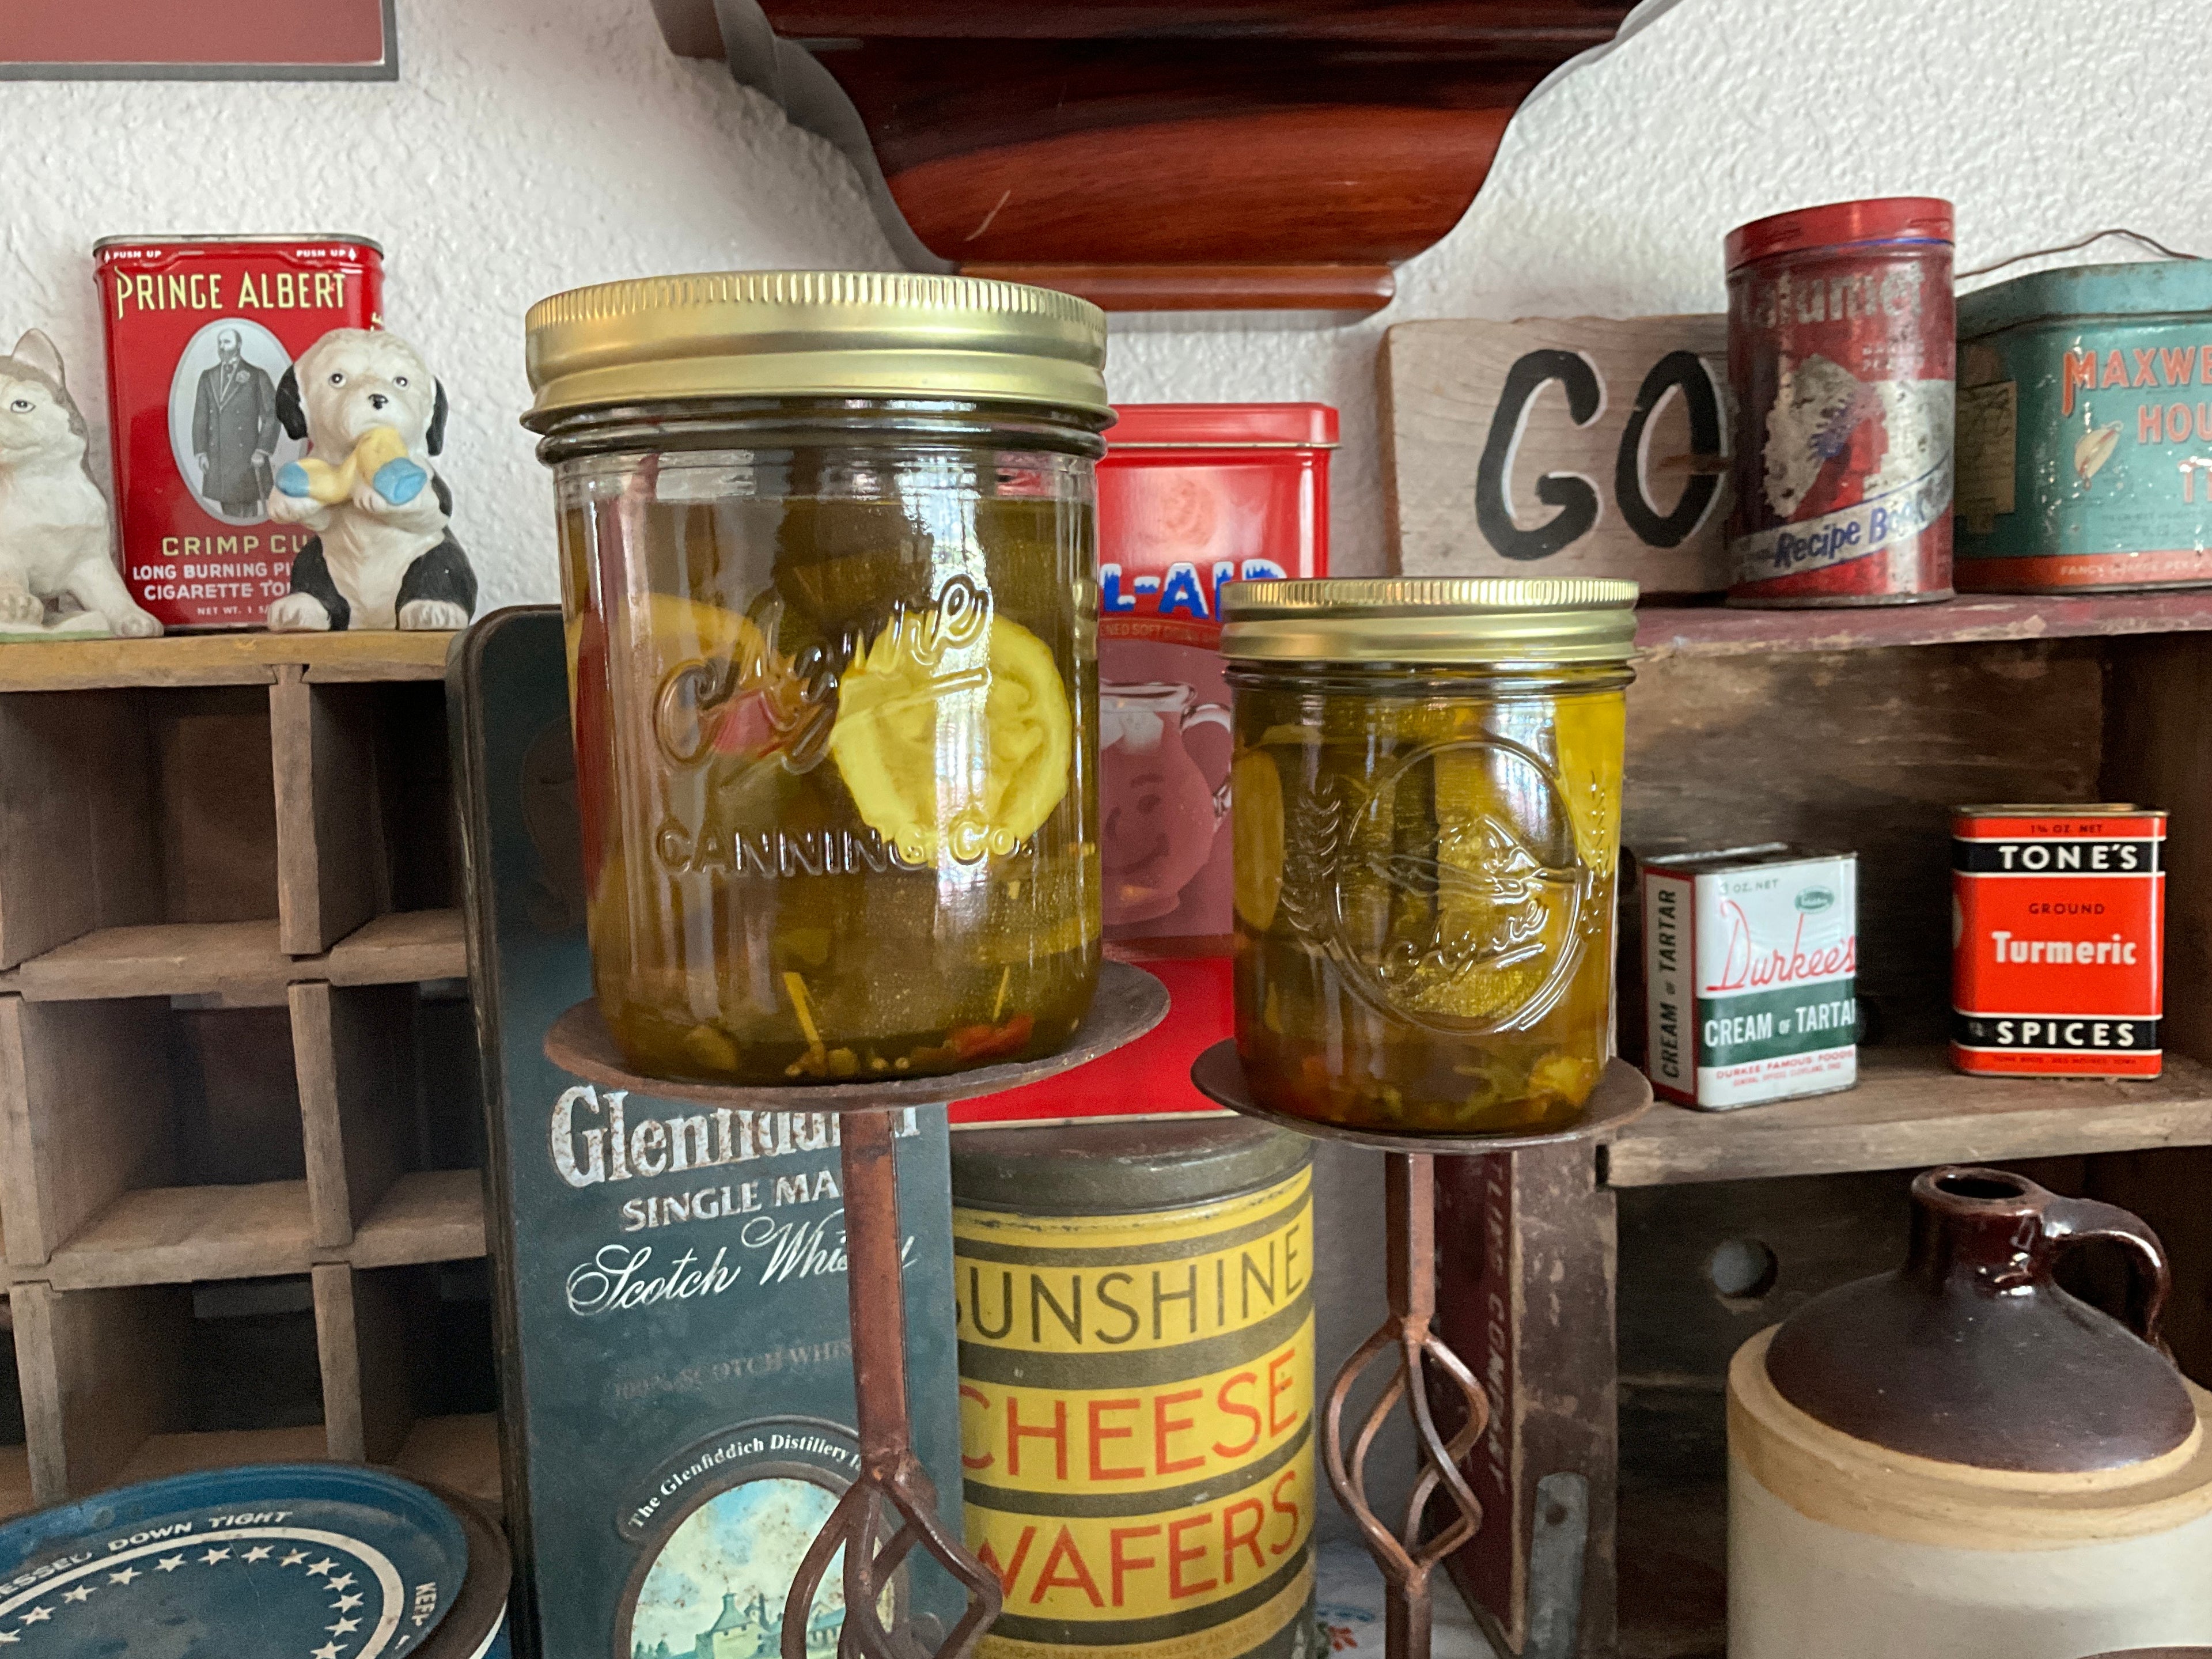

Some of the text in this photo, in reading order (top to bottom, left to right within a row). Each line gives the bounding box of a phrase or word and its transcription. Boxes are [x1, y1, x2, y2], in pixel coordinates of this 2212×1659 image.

[114, 266, 346, 320] PRINCE ALBERT
[2061, 345, 2212, 417] MAXWE
[2138, 402, 2212, 444] HOU
[162, 534, 308, 556] CRIMP CU
[1774, 520, 1861, 569] Recipe
[132, 562, 290, 581] LONG BURNING PI
[143, 582, 253, 600] CIGARETTE
[196, 606, 217, 615] NET
[2079, 824, 2103, 833] NET
[654, 827, 931, 877] CANNING
[1999, 844, 2138, 870] TONE'S
[1756, 879, 1779, 889] NET
[2028, 903, 2105, 915] GROUND
[1658, 889, 1677, 972] TARTAR
[1706, 900, 1855, 992] Durkee's
[1991, 931, 2137, 965] Turmeric
[1660, 1002, 1679, 1080] CREAM
[1705, 1012, 1772, 1047] CREAM
[1796, 998, 1856, 1033] TARTA
[1996, 1021, 2134, 1047] SPICES
[1716, 1065, 1760, 1080] DURKEE
[1767, 1058, 1812, 1069] FAMOUS
[623, 1170, 843, 1232] SINGLE MA
[566, 1244, 742, 1317] Scotch
[628, 1496, 661, 1529] The
[659, 1438, 764, 1494] Glenfiddich
[770, 1434, 850, 1464] Distillery
[108, 1521, 192, 1551] DOWN
[208, 1511, 293, 1529] TIGHT
